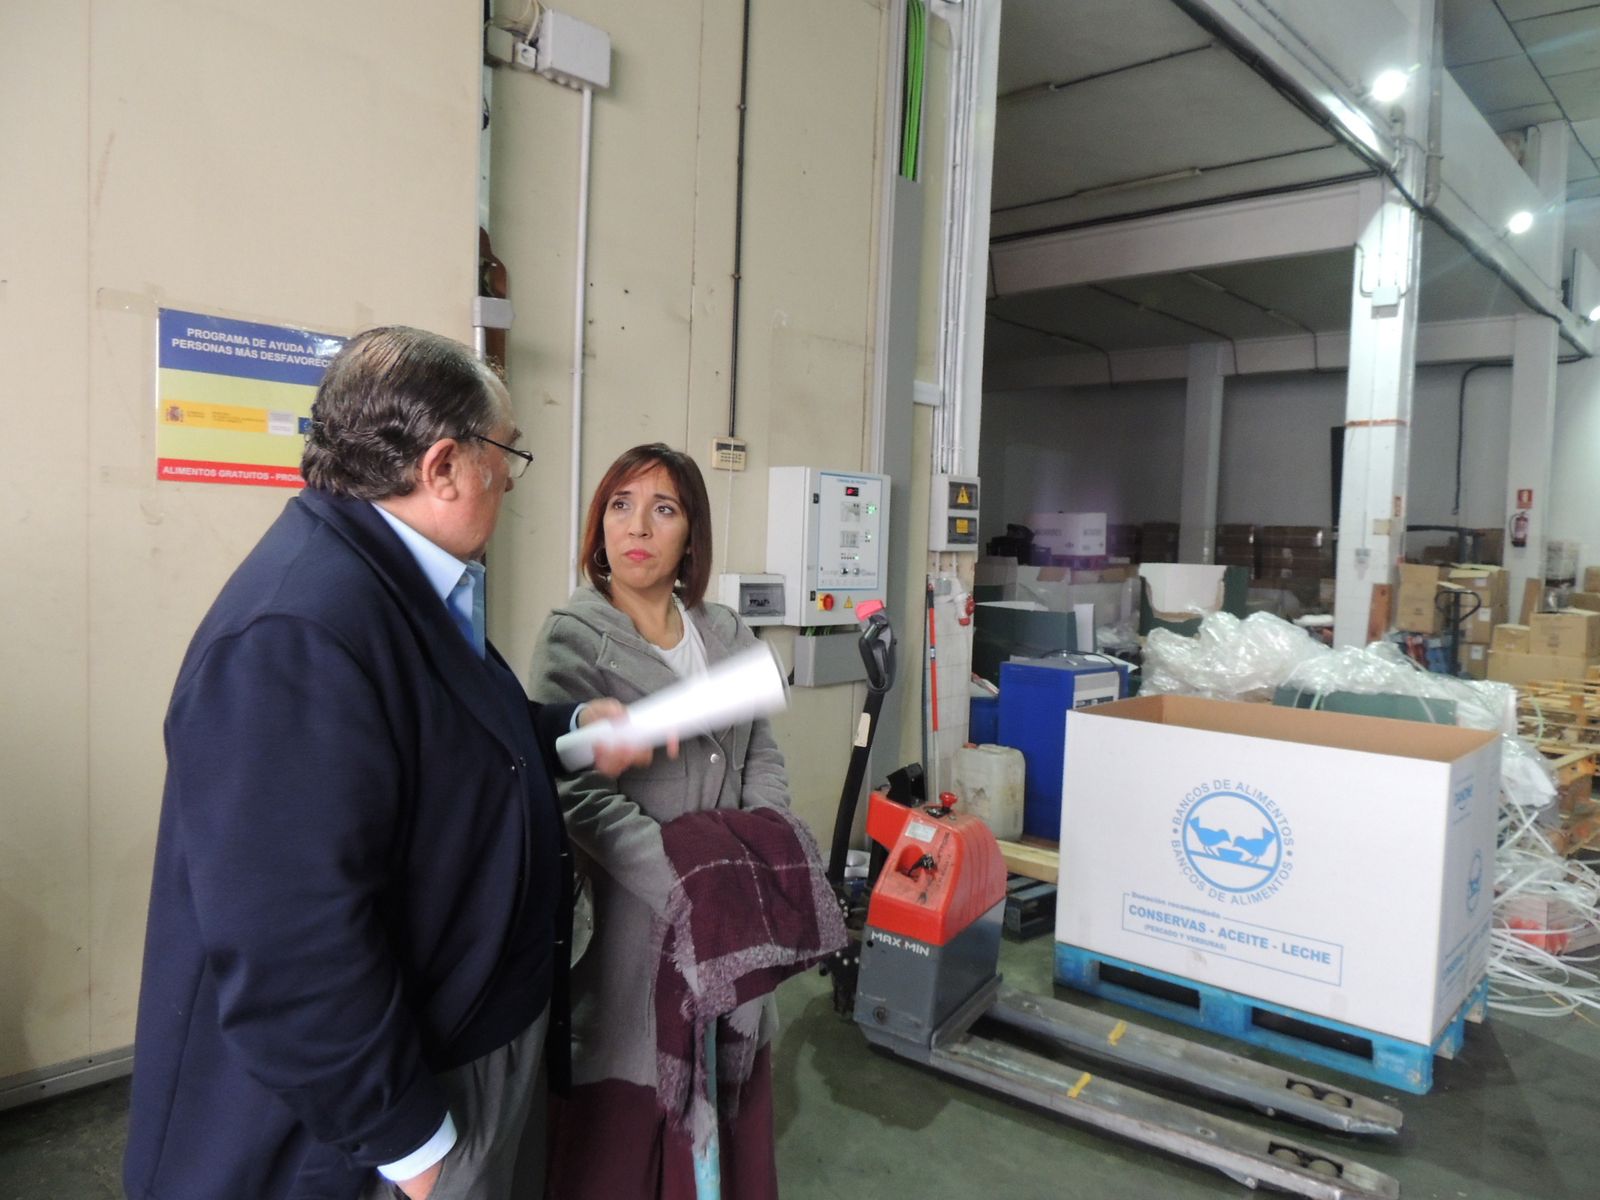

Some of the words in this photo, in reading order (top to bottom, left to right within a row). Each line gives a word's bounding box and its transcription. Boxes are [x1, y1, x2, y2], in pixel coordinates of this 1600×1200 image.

[171, 337, 233, 356] PERSONAS
[186, 327, 249, 346] PROGRAMA
[252, 337, 267, 349] DE
[269, 340, 304, 354] AYUDA
[306, 344, 315, 355] A
[162, 466, 217, 477] ALIMENTOS
[218, 469, 269, 480] GRATUITOS
[1172, 782, 1210, 826] BANCOS
[1213, 779, 1231, 790] DE
[1235, 781, 1294, 847] ALIMENTOS
[1171, 839, 1205, 891] BANCOS
[1208, 889, 1226, 903] DE
[1230, 861, 1293, 906] ALIMENTOS
[871, 930, 902, 948] MAX
[904, 942, 930, 957] MIN
[1128, 904, 1206, 933] CONSERVAS
[1217, 927, 1269, 949] ACEITE
[1281, 942, 1332, 965] LECHE
